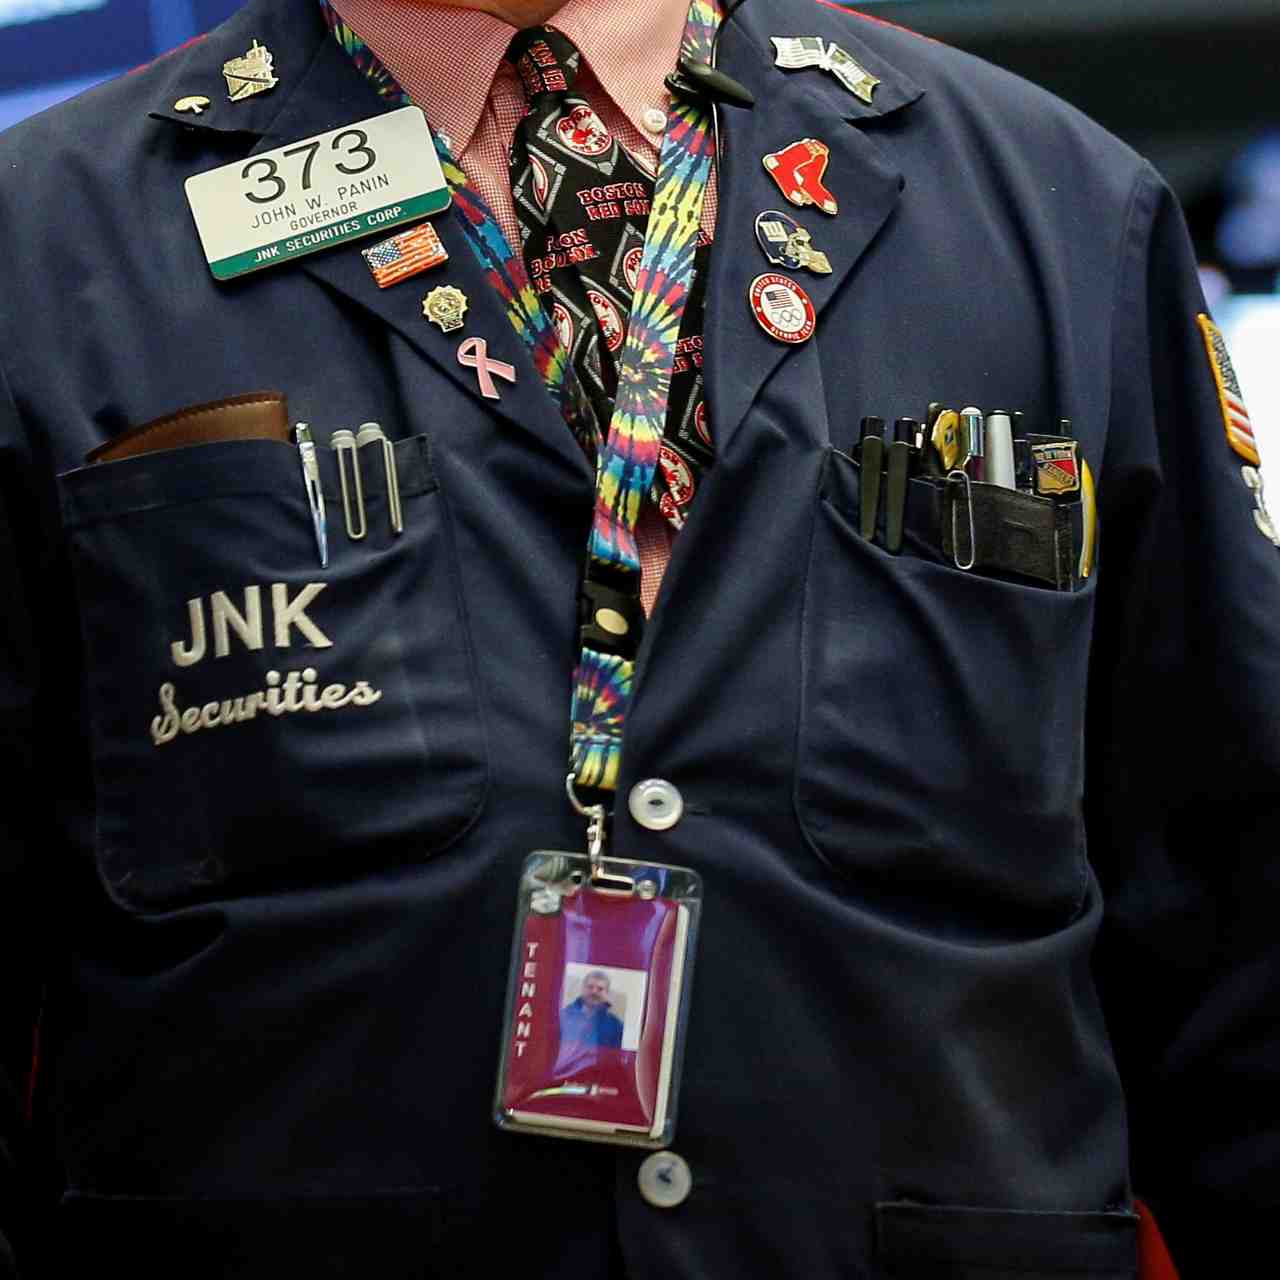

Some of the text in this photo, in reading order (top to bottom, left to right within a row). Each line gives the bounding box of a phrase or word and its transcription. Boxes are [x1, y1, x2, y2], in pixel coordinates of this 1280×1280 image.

[241, 129, 377, 204] 373
[576, 182, 647, 205] BOSTON
[251, 202, 297, 229] JOHN
[337, 173, 391, 201] PANIN
[289, 200, 359, 232] GOVERNOR
[585, 201, 622, 221] RED
[253, 246, 281, 263] JNK
[286, 221, 361, 252] SECURITIES
[171, 583, 334, 667] JNK
[151, 668, 382, 747] Securities
[515, 942, 539, 1057] TENANT
